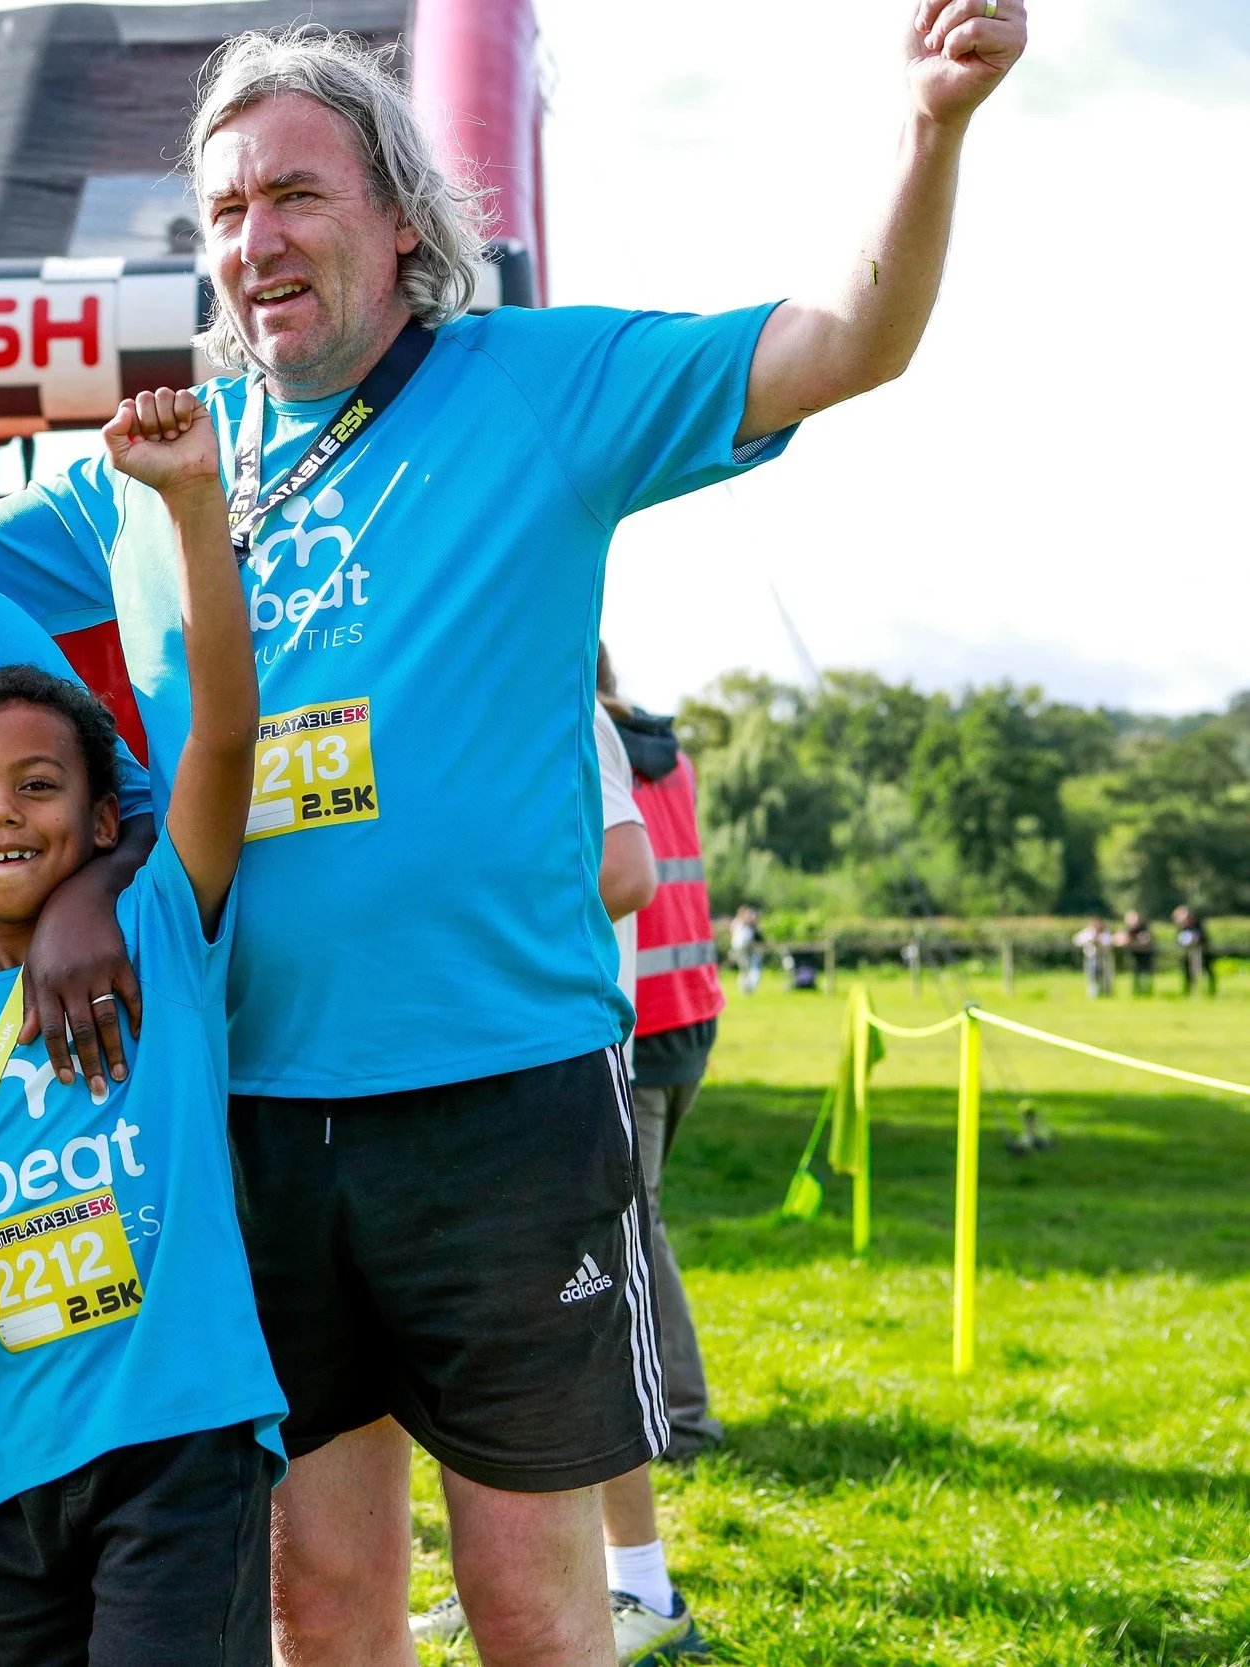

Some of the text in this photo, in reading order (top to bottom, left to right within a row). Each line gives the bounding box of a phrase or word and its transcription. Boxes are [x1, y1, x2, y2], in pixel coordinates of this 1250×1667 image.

[255, 704, 369, 742] FLATABLE5K
[252, 735, 349, 796] 213
[301, 784, 376, 821] 2.5K
[66, 1278, 143, 1325] 2.5K
[559, 1274, 613, 1303] adidas
